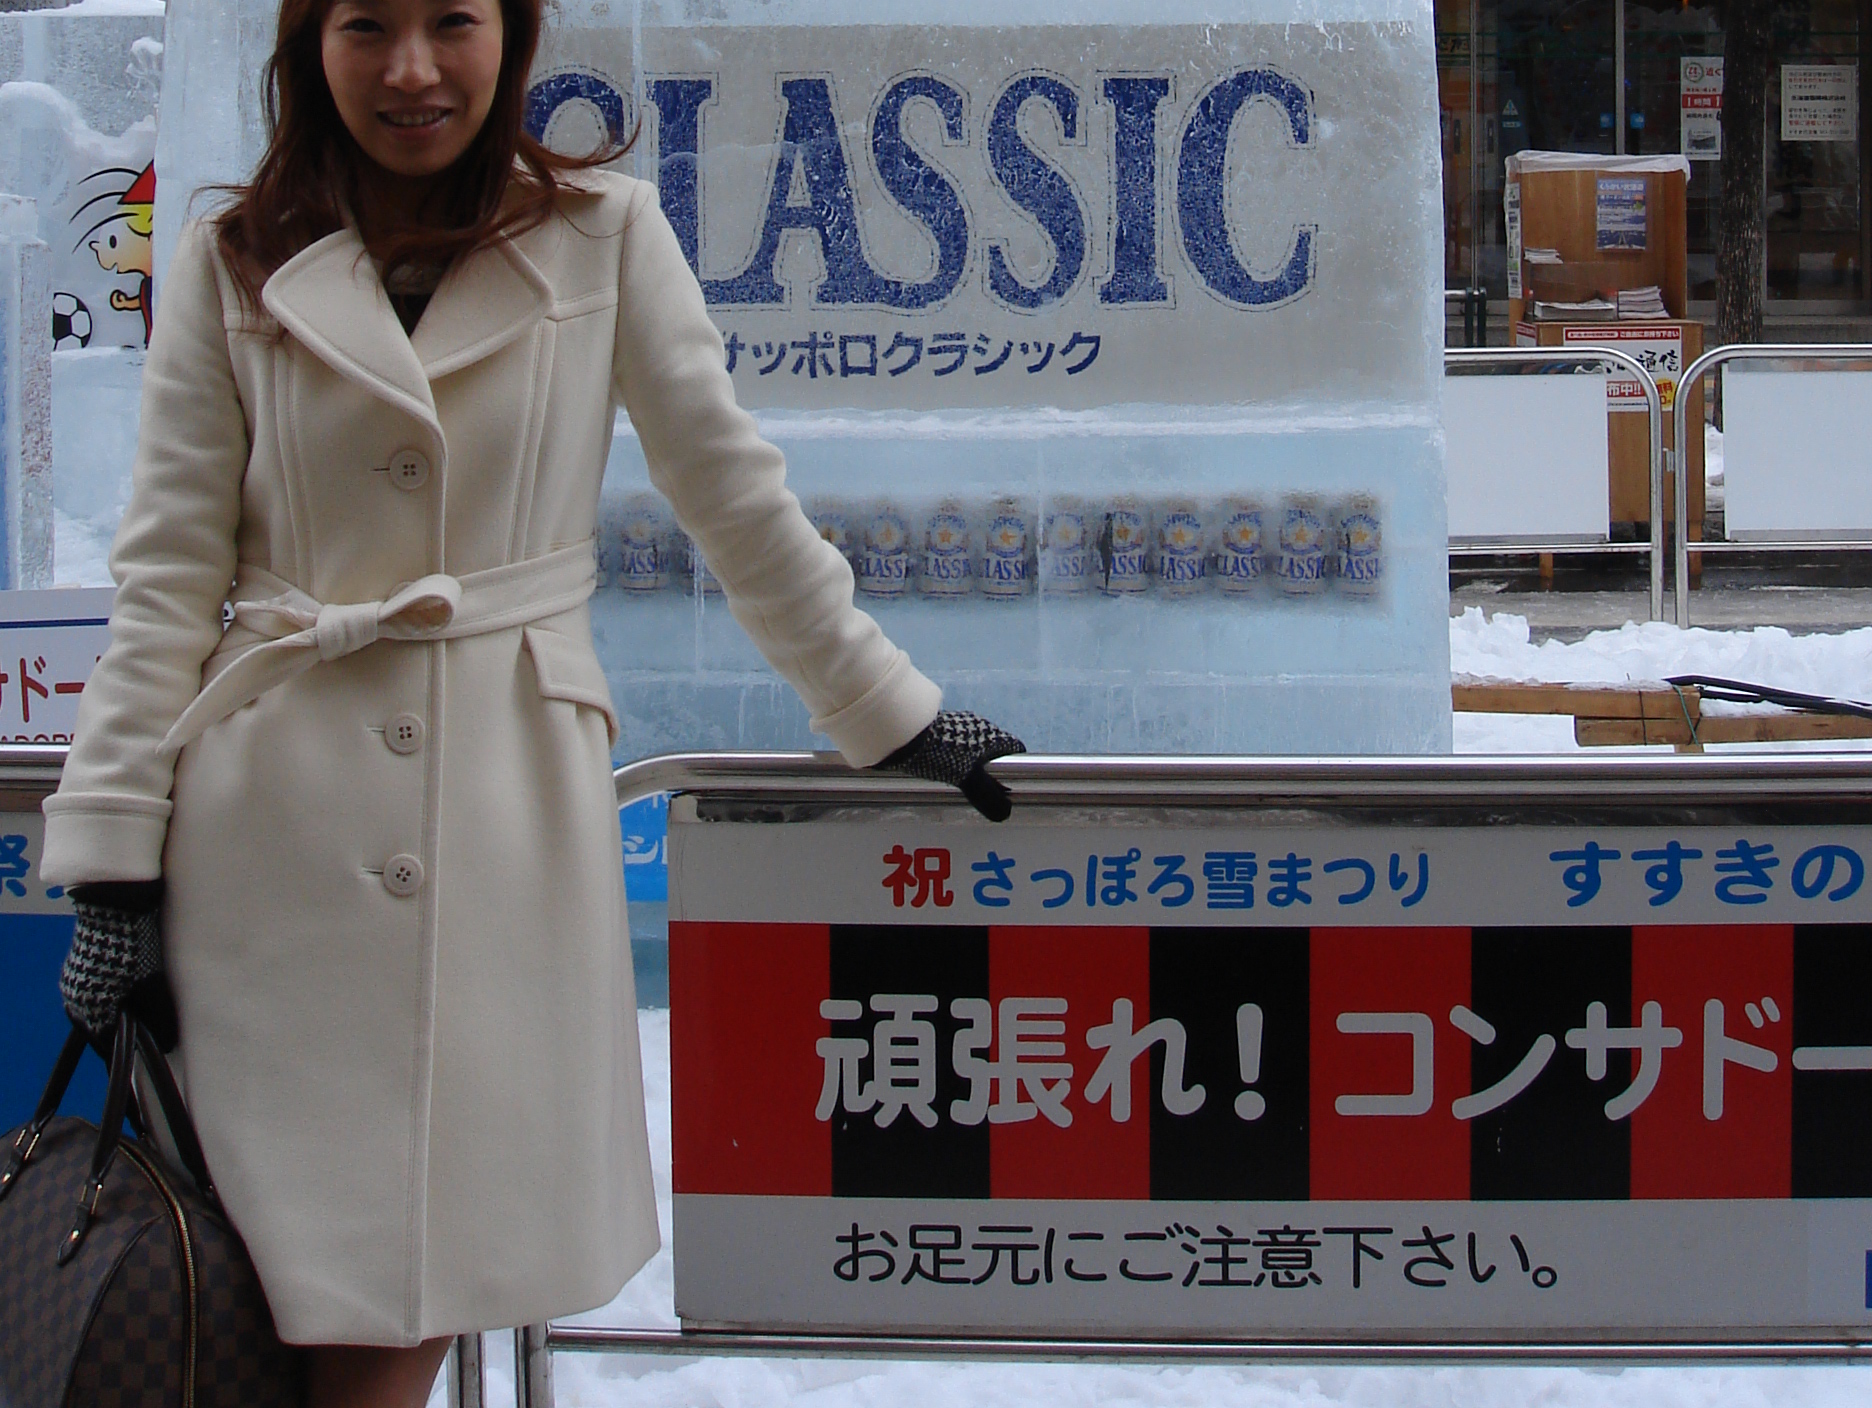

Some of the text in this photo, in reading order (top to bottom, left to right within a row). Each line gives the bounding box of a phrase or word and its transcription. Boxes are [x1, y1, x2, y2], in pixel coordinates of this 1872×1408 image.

[1549, 839, 1866, 908] すすきの
[815, 993, 1266, 1129] 頑張れ!
[833, 1222, 1558, 1289] お足元にご注意下さい。
